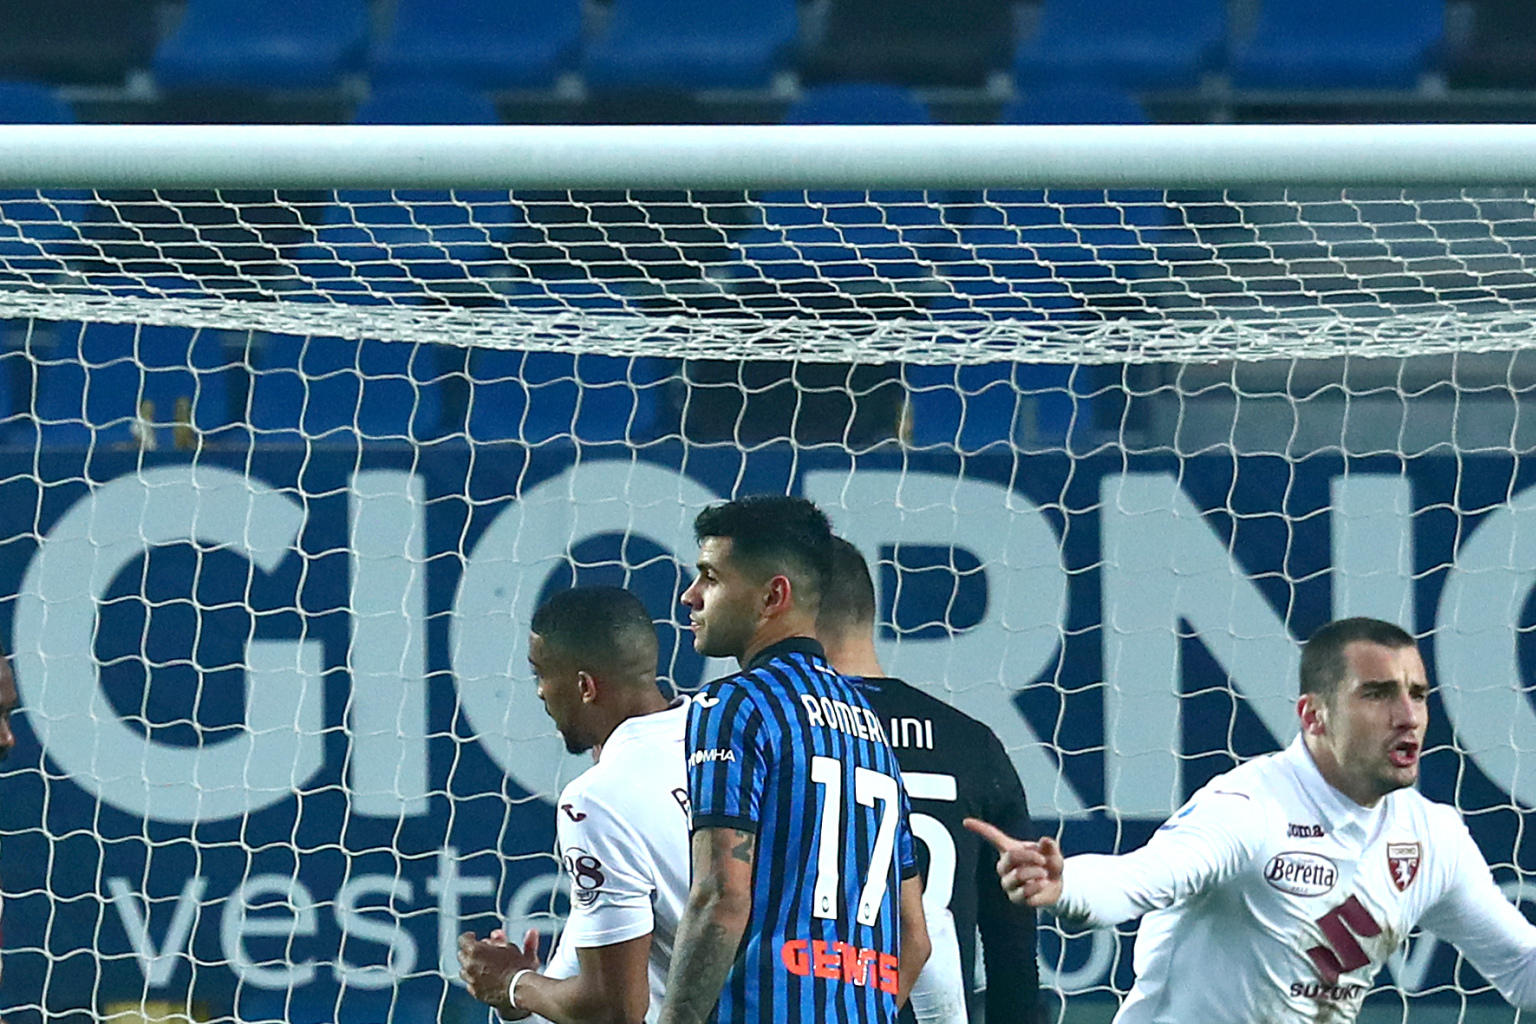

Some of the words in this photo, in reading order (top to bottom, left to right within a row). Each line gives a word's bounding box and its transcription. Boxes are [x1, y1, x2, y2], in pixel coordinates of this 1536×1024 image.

[801, 694, 889, 748] ROMER
[811, 756, 898, 927] 17
[1267, 857, 1335, 887] Beretta
